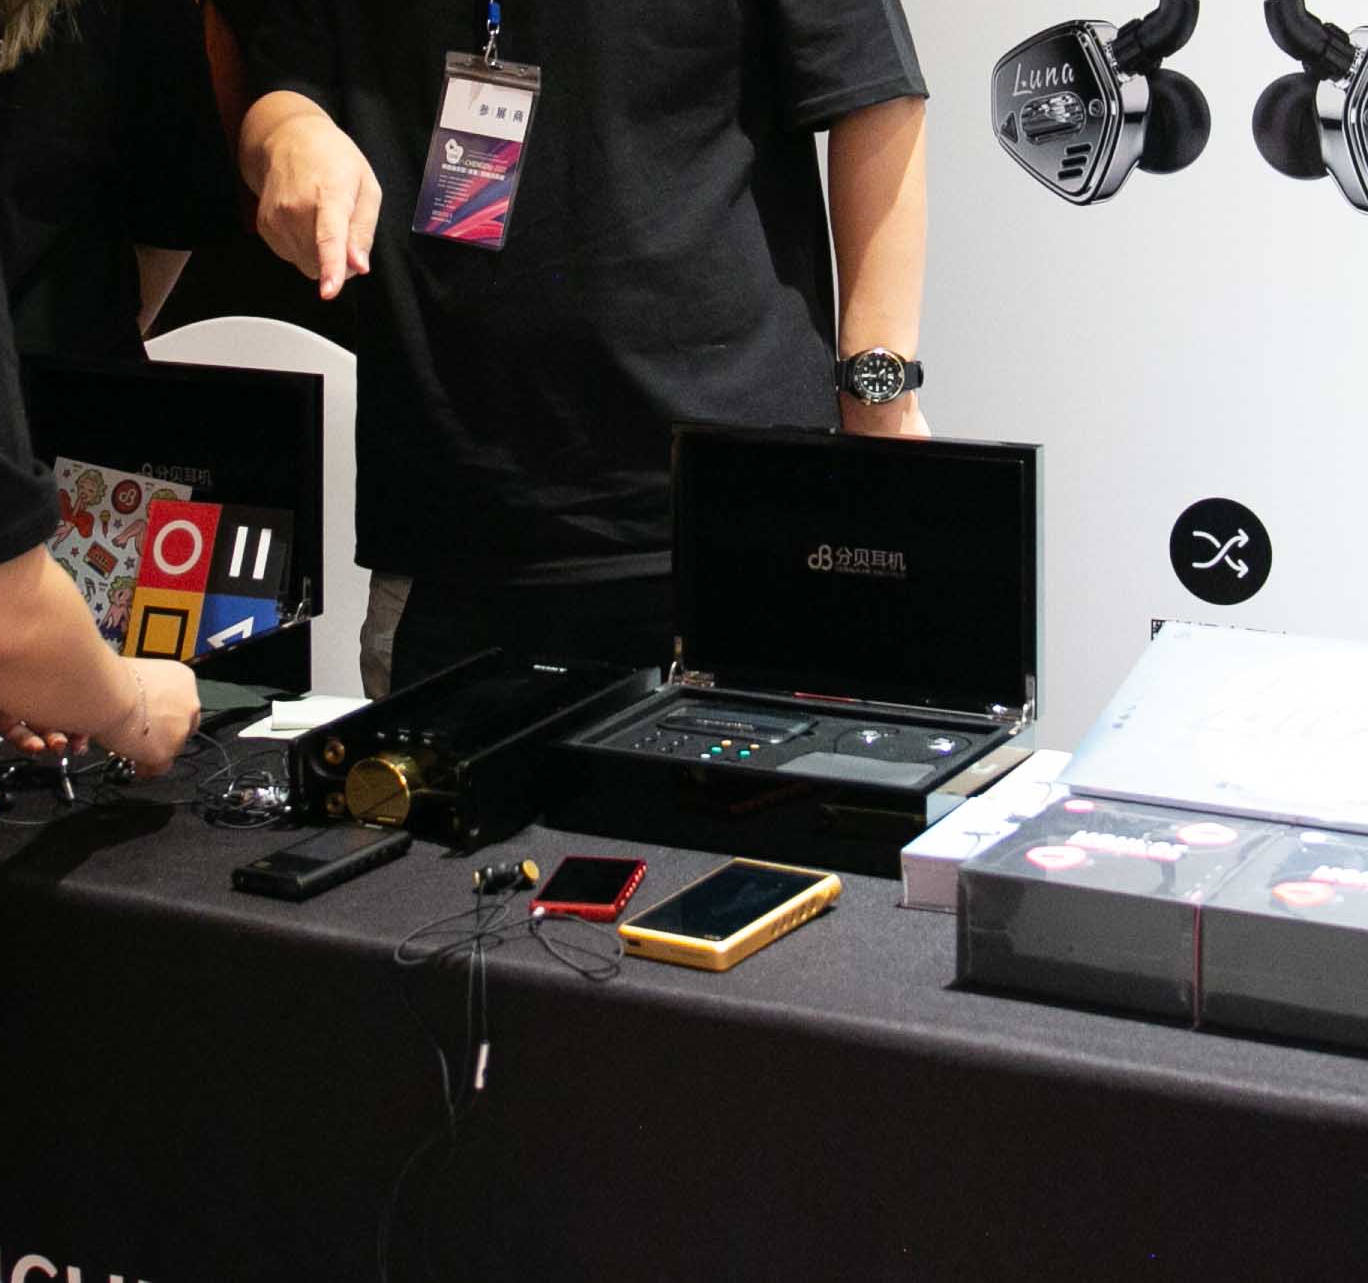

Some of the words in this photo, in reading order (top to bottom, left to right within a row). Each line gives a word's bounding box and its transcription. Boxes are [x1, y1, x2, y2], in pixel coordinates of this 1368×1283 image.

[1013, 61, 1075, 96] Luna
[835, 547, 906, 571] 分贝耳机
